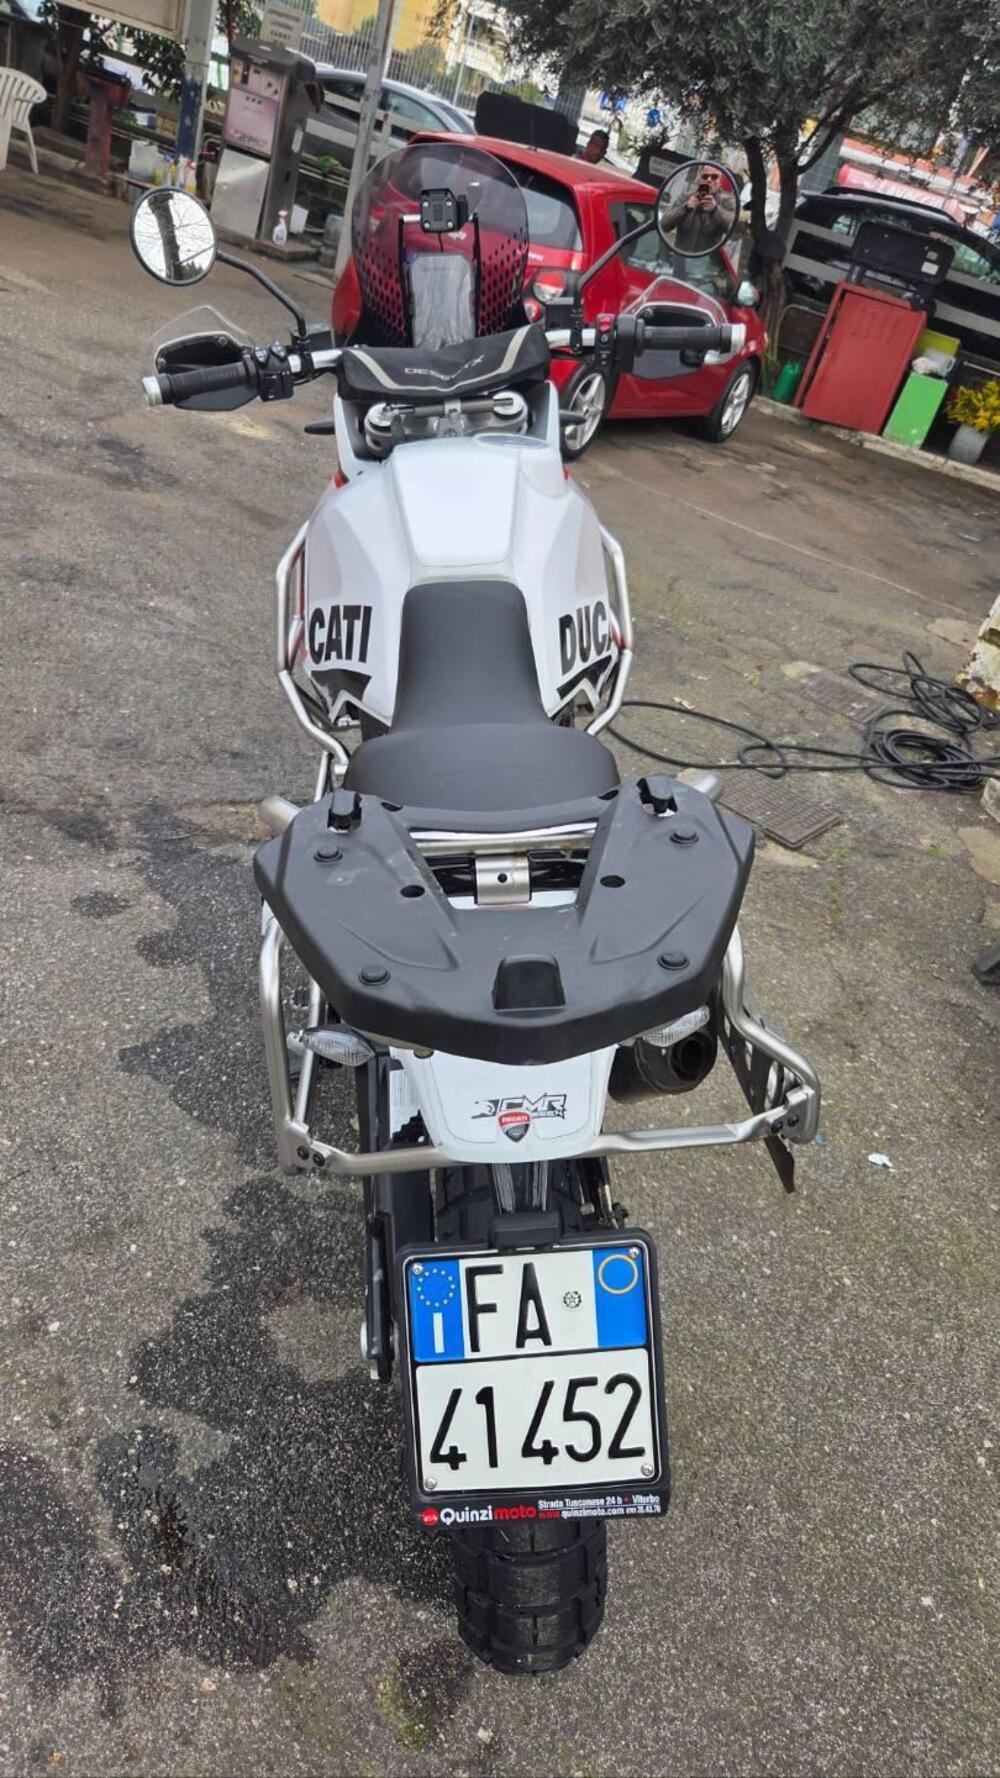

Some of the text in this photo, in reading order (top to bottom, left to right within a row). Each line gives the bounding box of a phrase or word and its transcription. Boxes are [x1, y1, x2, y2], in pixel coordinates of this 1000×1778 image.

[309, 605, 372, 664] CATI
[501, 1114, 528, 1123] DUCATI
[538, 1498, 563, 1510] Strada
[606, 1496, 616, 1505] 24
[632, 1493, 660, 1504] Viterbo
[561, 1506, 624, 1519] quinzimoto.com
